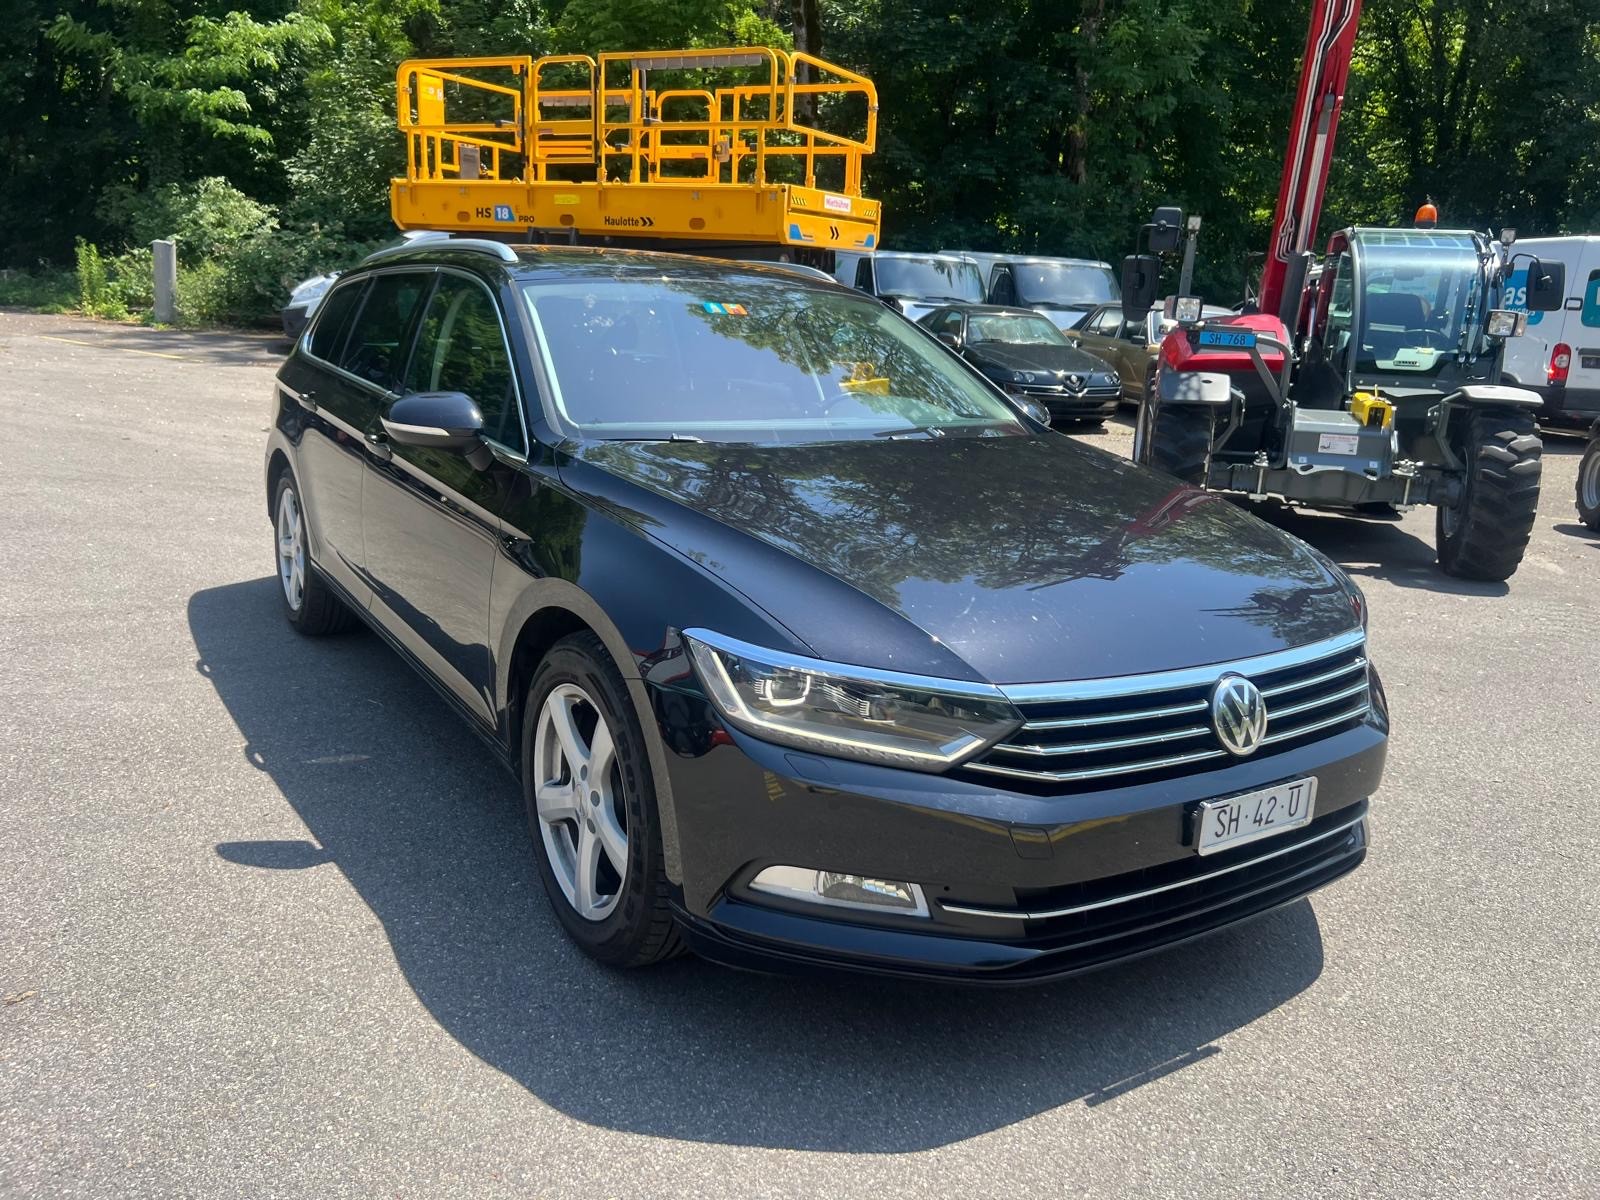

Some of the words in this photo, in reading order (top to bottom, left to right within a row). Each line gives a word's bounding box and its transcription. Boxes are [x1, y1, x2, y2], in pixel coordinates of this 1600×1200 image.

[475, 207, 492, 218] HS
[496, 207, 509, 220] 18
[518, 215, 535, 223] PRO
[604, 216, 640, 226] Haulotte
[1209, 333, 1222, 344] SH
[1228, 334, 1246, 345] 768
